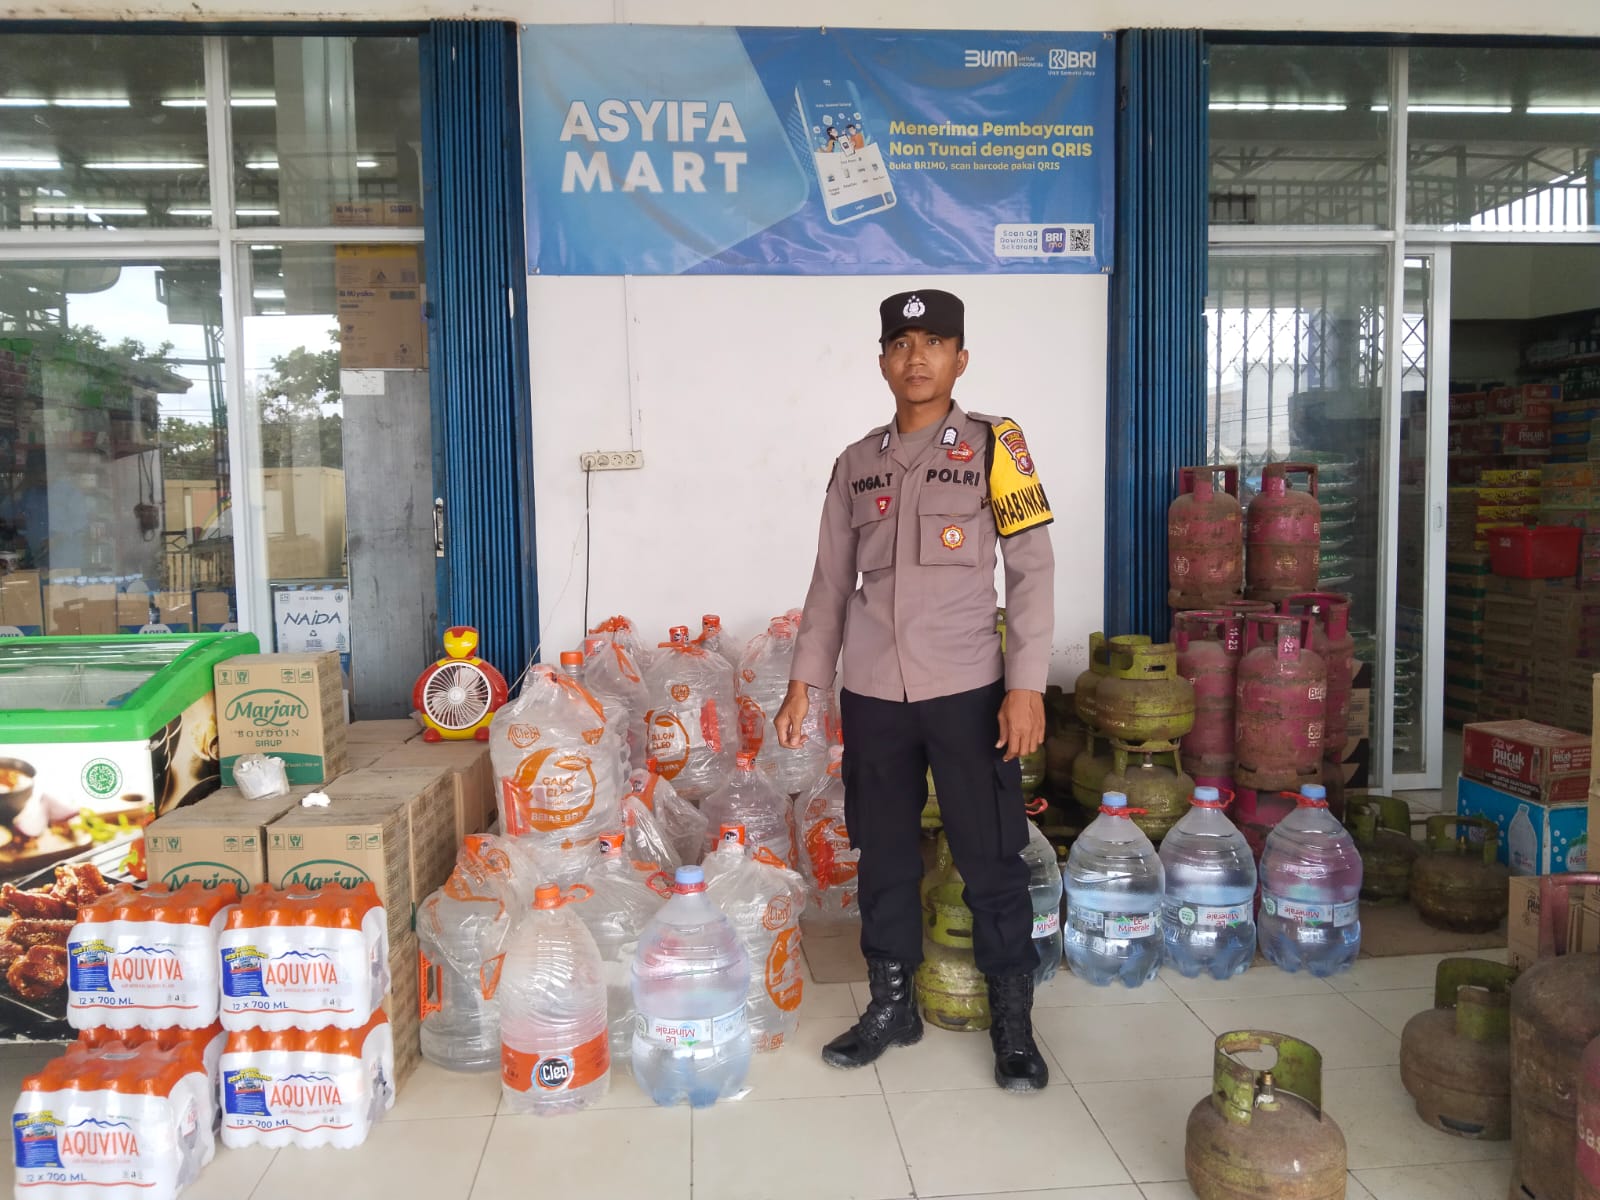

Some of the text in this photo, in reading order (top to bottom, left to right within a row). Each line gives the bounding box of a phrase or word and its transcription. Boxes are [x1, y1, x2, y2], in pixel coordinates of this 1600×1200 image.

[964, 50, 1018, 68] BUMN
[1067, 51, 1096, 68] BRI
[559, 99, 747, 142] ASYIFA
[889, 120, 1094, 139] Menerima Pembayaran
[890, 142, 1093, 160] Non Tunai dengan QRIS
[561, 151, 748, 193] MART
[889, 162, 912, 170] Buka
[914, 162, 948, 171] BRIMO,
[973, 162, 1009, 170] barcode
[1038, 162, 1061, 171] QRIS
[1046, 233, 1063, 242] BRI
[926, 468, 980, 487] POLRI
[851, 473, 893, 495] YOGA.T
[228, 697, 308, 727] Marjan
[255, 740, 283, 748] SIRUP
[1206, 913, 1240, 921] Minerale
[1284, 907, 1320, 918] Minerale
[1132, 916, 1142, 925] Le
[1216, 920, 1226, 928] Le
[1293, 915, 1303, 924] Le
[1118, 922, 1150, 932] Minerale
[111, 958, 184, 982] AQUVIVA
[266, 962, 338, 986] AQUVIVA
[98, 996, 116, 1005] 700
[118, 997, 135, 1005] ML
[252, 1000, 270, 1010] 700
[273, 1000, 288, 1009] ML
[656, 1026, 696, 1038] Minerale
[666, 1035, 676, 1046] Le
[542, 1065, 568, 1080] Cleo
[270, 1084, 342, 1108] AQUVIVA
[257, 1119, 273, 1128] 700
[275, 1119, 292, 1127] ML
[62, 1132, 140, 1157] AQUVIVA
[46, 1172, 67, 1182] 700
[70, 1173, 88, 1182] ML
